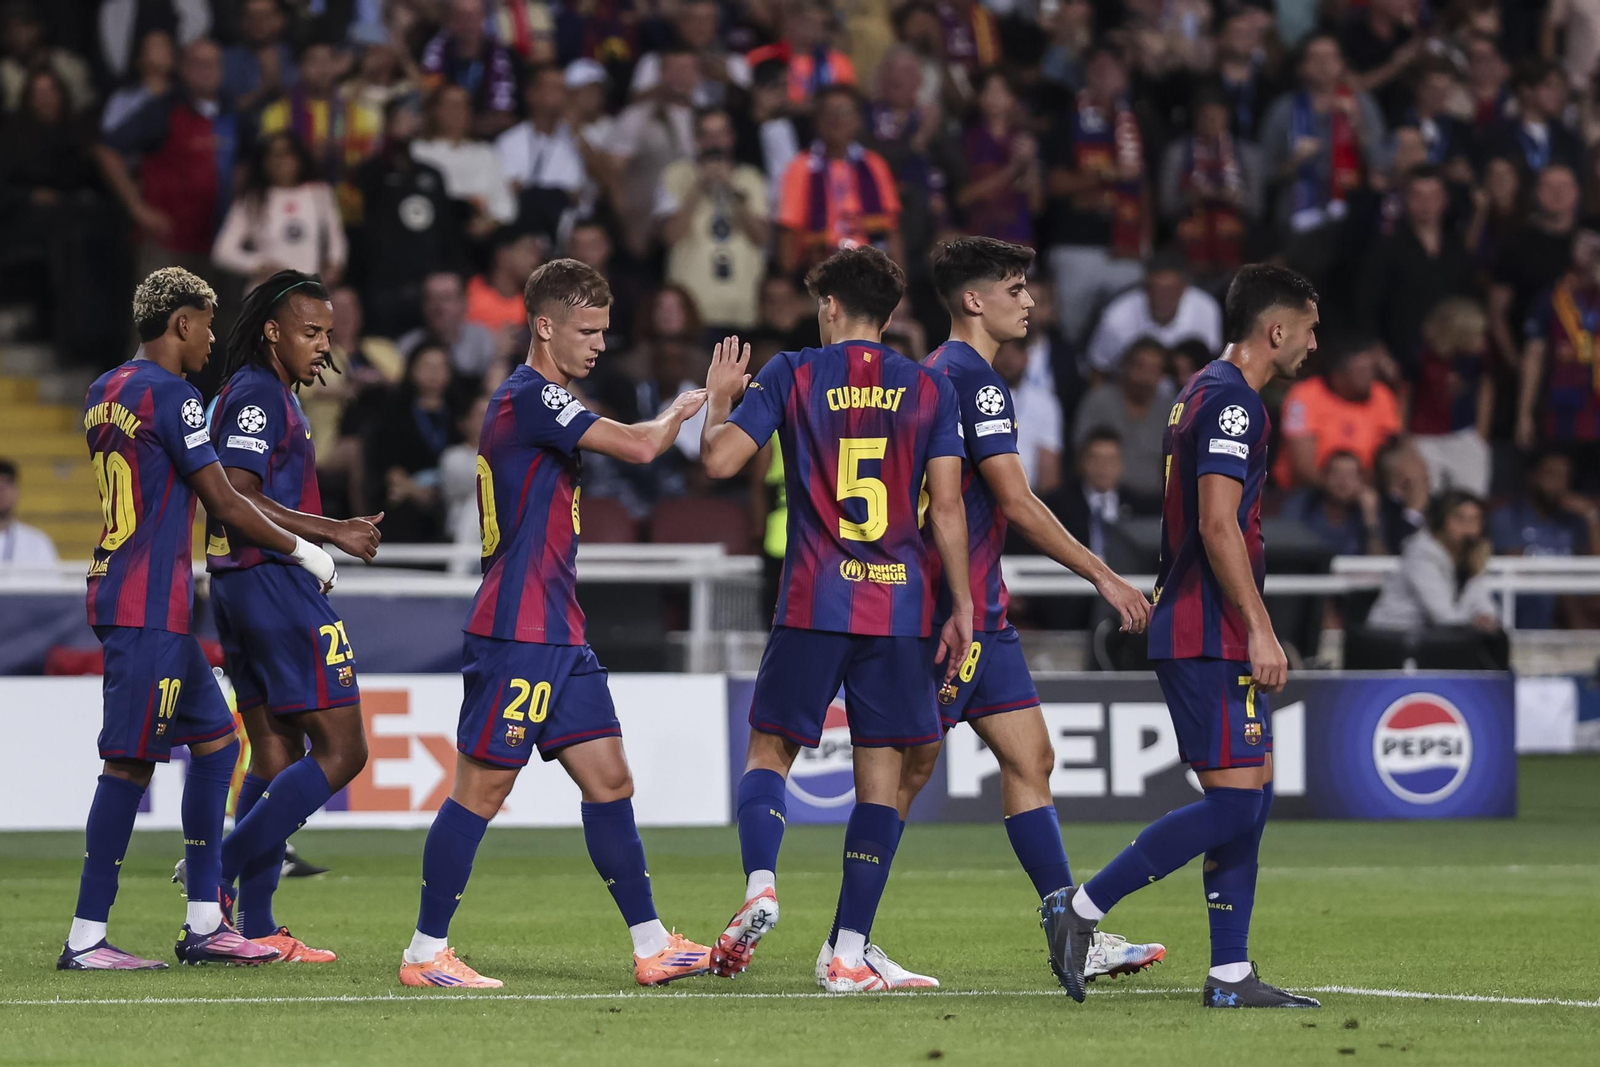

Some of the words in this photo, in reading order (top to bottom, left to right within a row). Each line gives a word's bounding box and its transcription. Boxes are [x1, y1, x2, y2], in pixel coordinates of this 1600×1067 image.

[826, 385, 907, 413] CUBARSÍ
[110, 401, 142, 439] YAMAL
[91, 451, 137, 551] 10
[837, 437, 889, 542] 5
[867, 562, 906, 573] UNHCR
[868, 571, 907, 581] ACNUR
[158, 677, 182, 719] 10
[502, 678, 552, 723] 20
[1383, 737, 1463, 756] PEPSI
